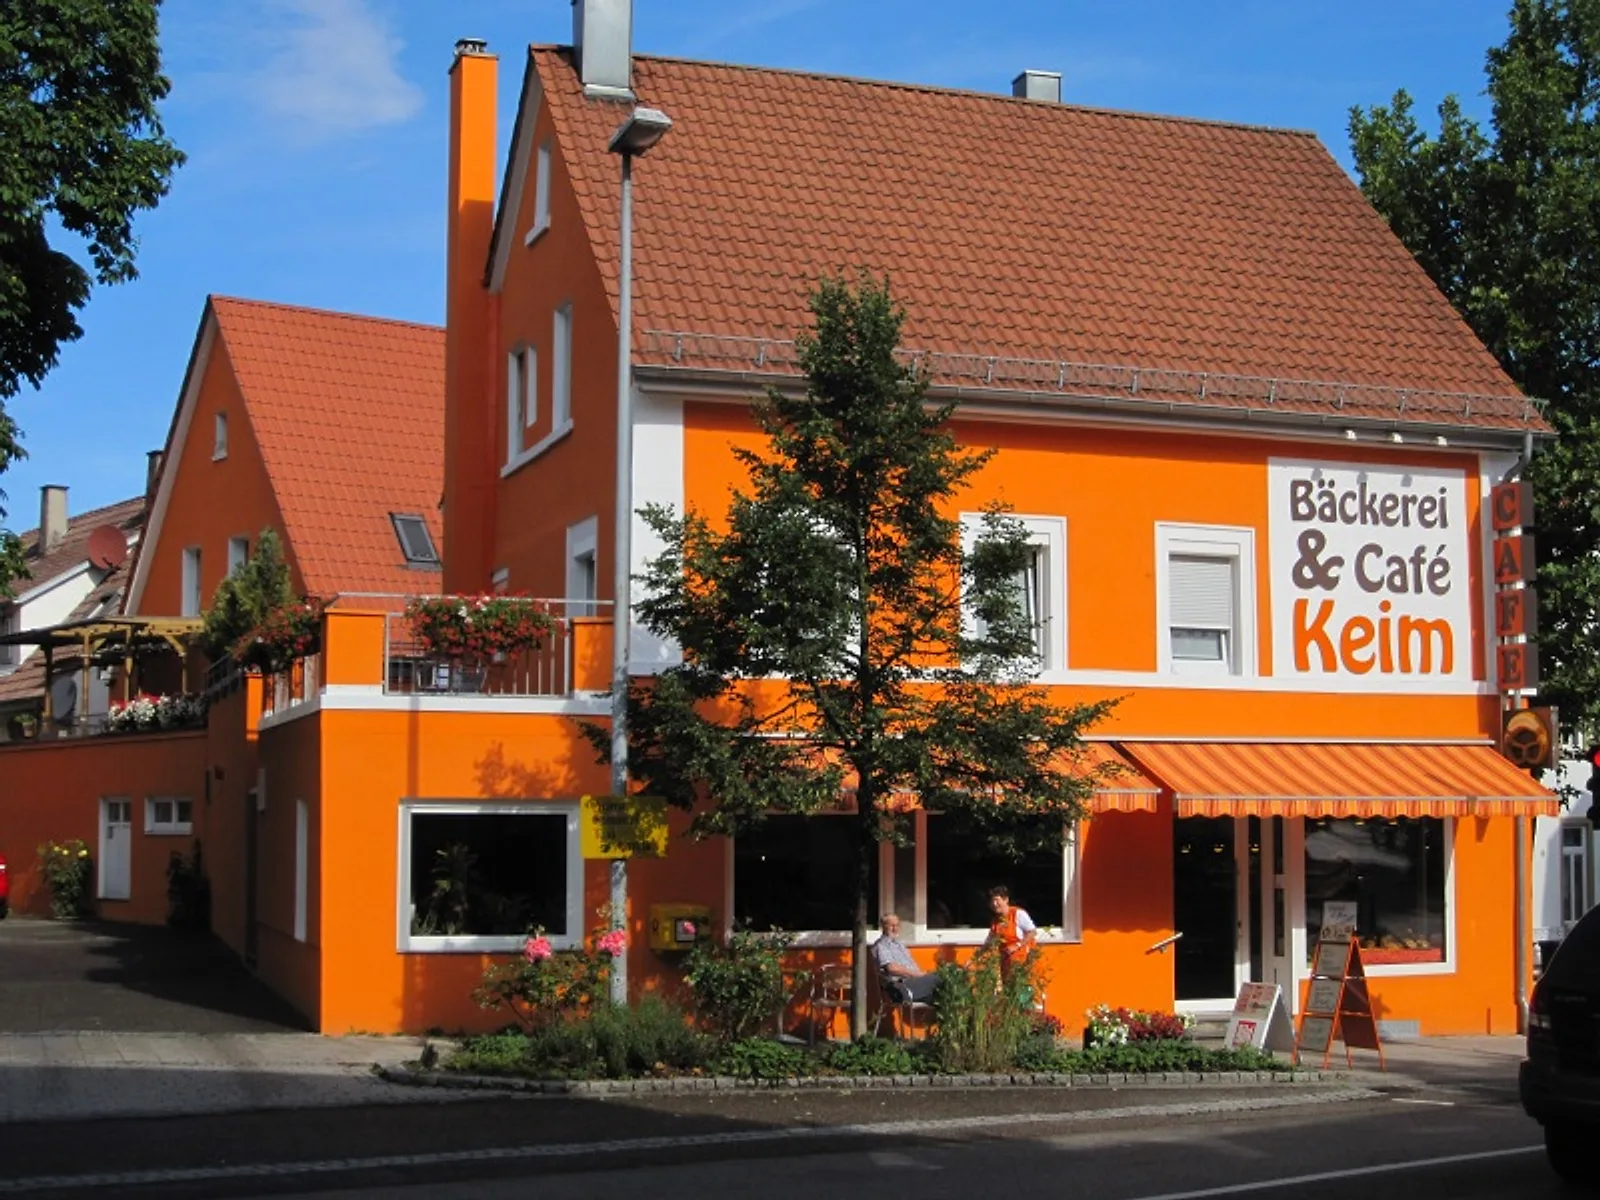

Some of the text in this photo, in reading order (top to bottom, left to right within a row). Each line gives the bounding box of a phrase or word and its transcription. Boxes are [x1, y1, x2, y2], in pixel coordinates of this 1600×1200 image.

[1290, 478, 1448, 529] Bäckerei
[1291, 528, 1452, 595] & Café
[1292, 598, 1454, 675] Keim
